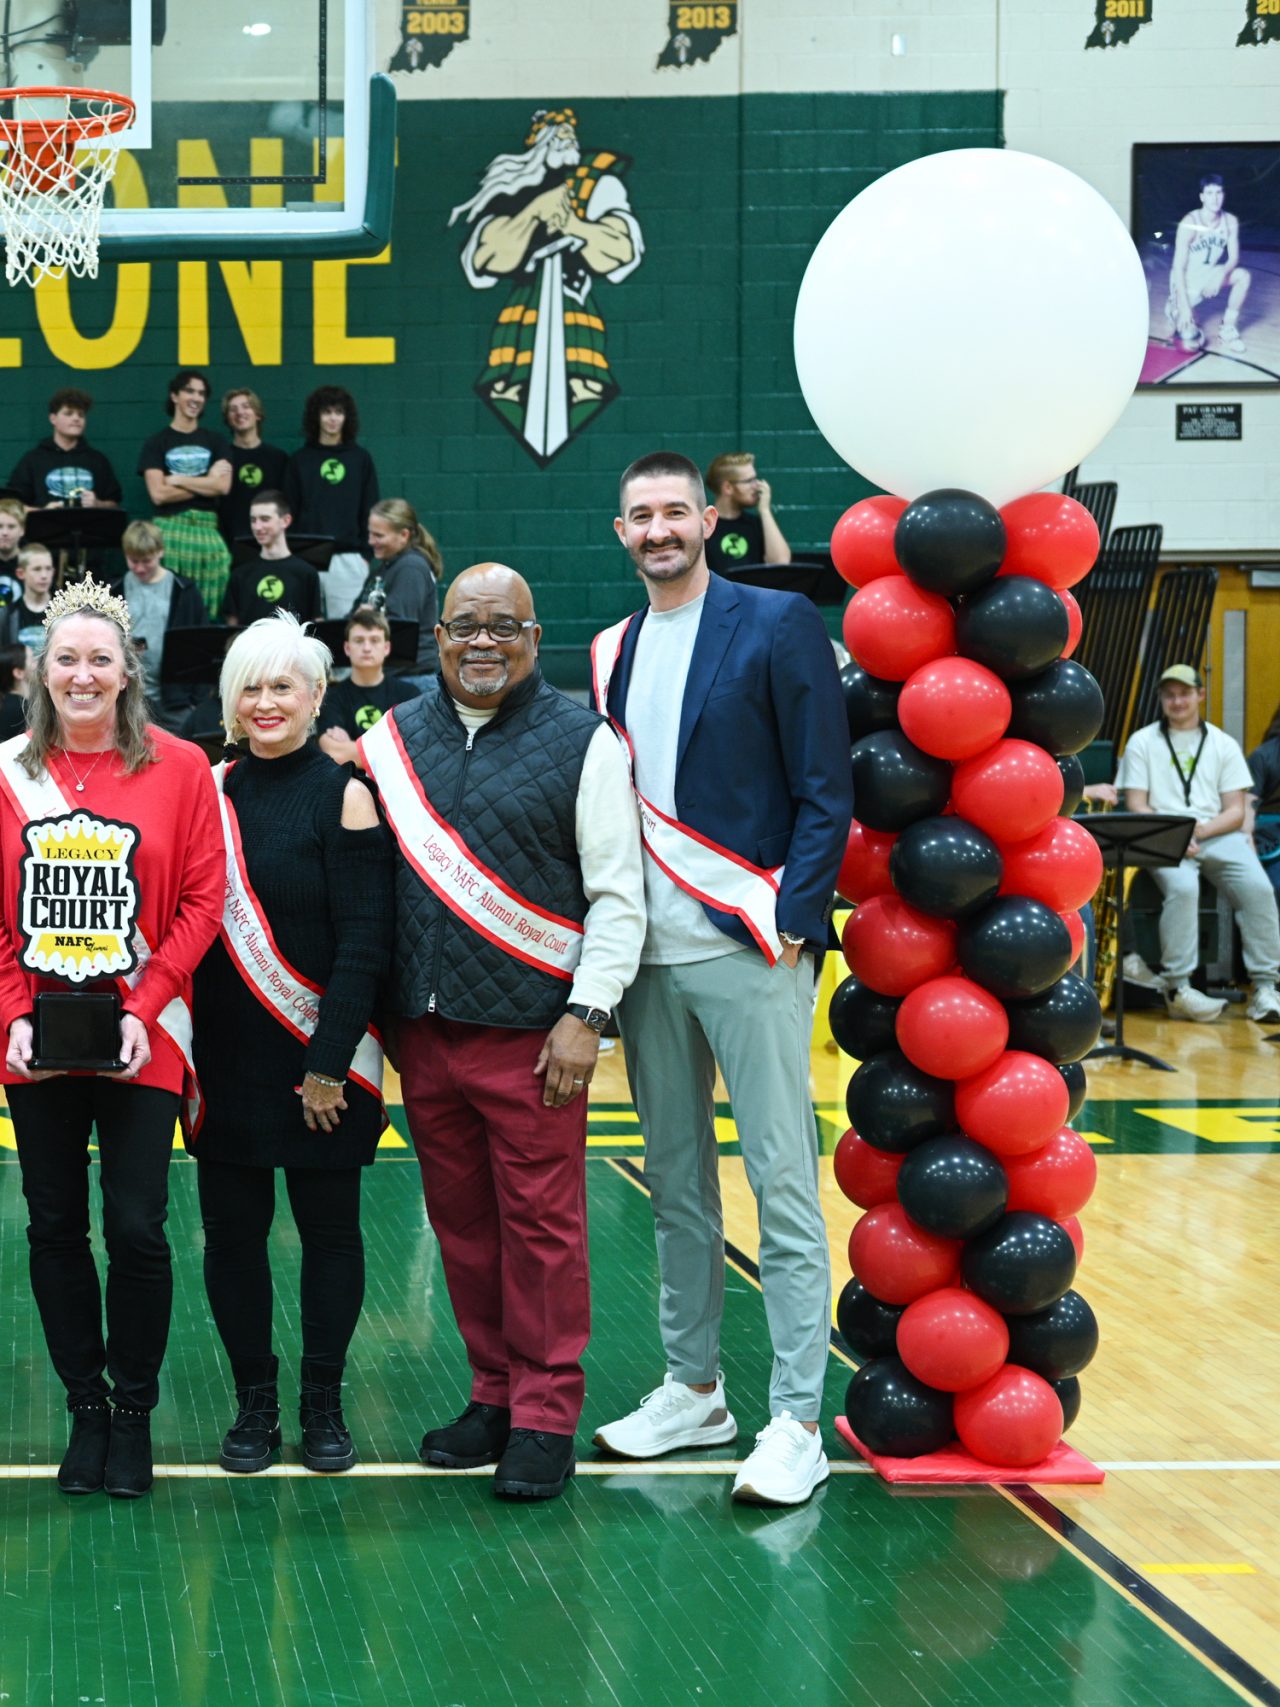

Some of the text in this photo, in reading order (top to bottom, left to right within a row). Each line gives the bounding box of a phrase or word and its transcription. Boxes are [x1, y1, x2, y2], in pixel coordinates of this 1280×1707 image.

[677, 6, 730, 29] 2013
[1105, 0, 1145, 17] 2011
[407, 12, 465, 34] 2003
[46, 847, 117, 860] LEGACY
[32, 863, 128, 897] ROYAL
[423, 834, 569, 955] Legacy NAFC Alumni Royal Court
[30, 896, 129, 930] COURT
[55, 936, 93, 947] NAFC
[228, 899, 250, 932] NAFC
[243, 932, 272, 972] Alumni
[267, 970, 296, 1000] Royal
